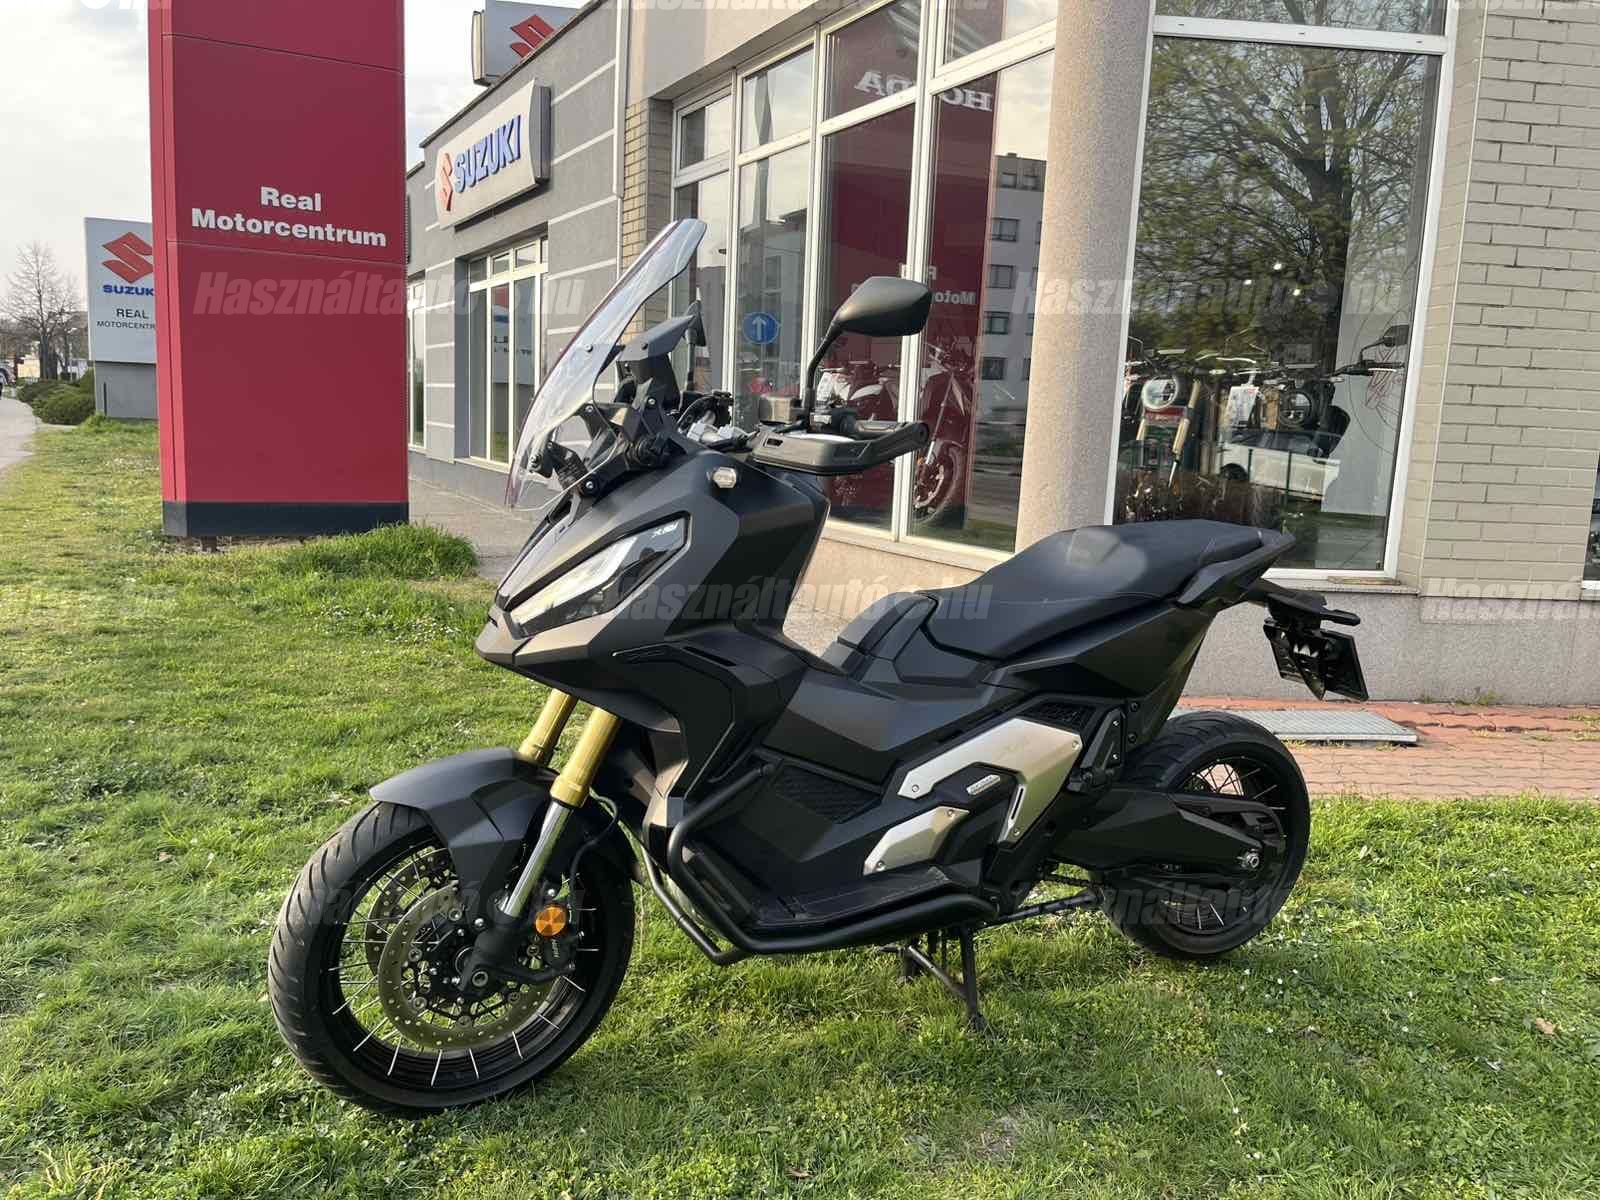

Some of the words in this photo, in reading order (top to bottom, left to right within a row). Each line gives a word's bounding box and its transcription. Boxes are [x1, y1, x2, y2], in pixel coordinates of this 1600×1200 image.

[455, 114, 521, 193] SUZUKI
[260, 186, 322, 211] Real
[191, 207, 387, 247] Motorcentrum
[102, 284, 154, 296] SUZUK
[116, 308, 149, 319] REAL
